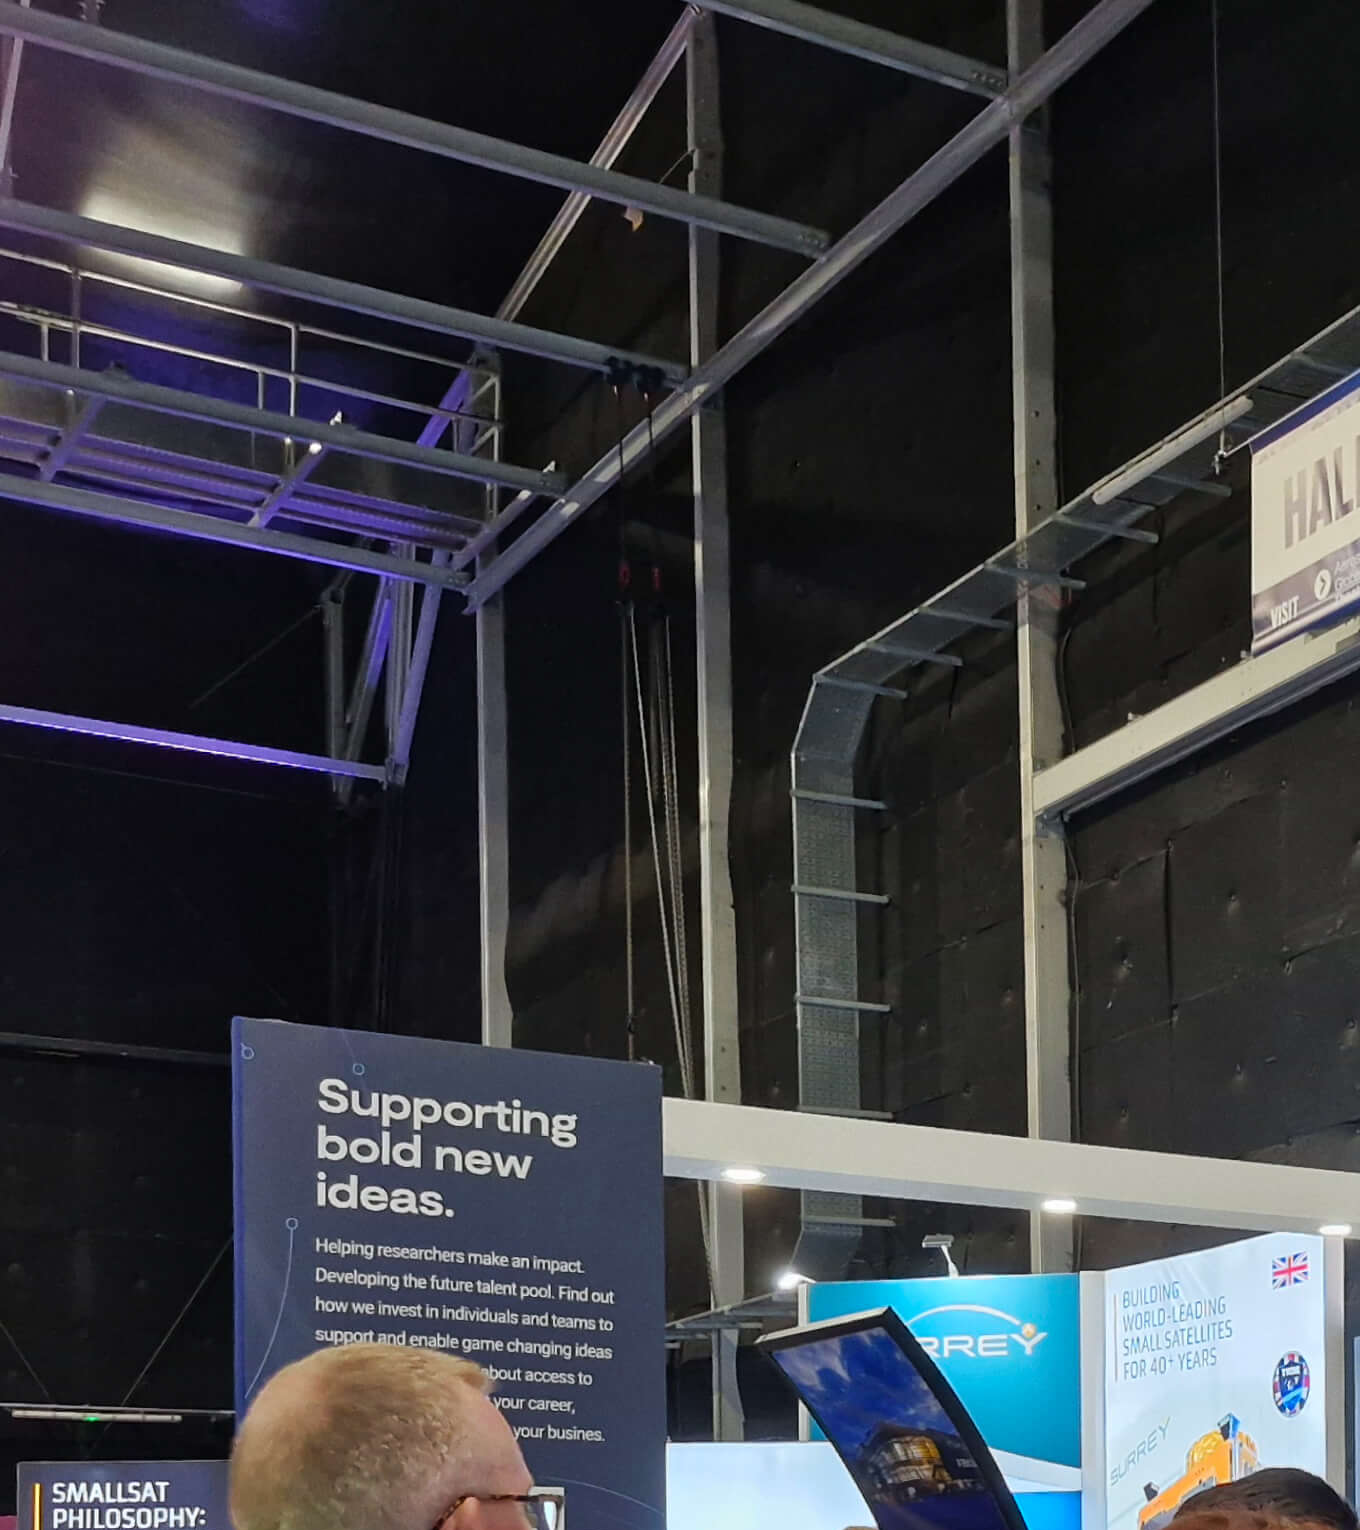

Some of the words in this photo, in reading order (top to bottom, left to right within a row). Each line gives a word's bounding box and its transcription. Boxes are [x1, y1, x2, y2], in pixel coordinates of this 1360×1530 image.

[1270, 595, 1299, 628] VISIT
[317, 1078, 578, 1147] Supporting
[317, 1125, 421, 1167] bold
[435, 1146, 533, 1178] new
[316, 1172, 454, 1216] ideas.
[315, 1237, 374, 1260] Helping
[377, 1245, 465, 1263] researchers
[467, 1251, 509, 1267] make
[510, 1256, 530, 1269] an
[532, 1255, 585, 1274] impact.
[315, 1267, 400, 1290] Developing
[402, 1272, 427, 1289] the
[429, 1274, 473, 1292] future
[476, 1279, 517, 1296] talent
[519, 1284, 554, 1300] pool.
[558, 1285, 588, 1302] Find
[590, 1290, 614, 1304] out
[1122, 1280, 1180, 1309] BUILDING
[314, 1295, 348, 1313] how
[351, 1302, 375, 1315] we
[377, 1300, 422, 1317] invest
[425, 1303, 439, 1319] in
[441, 1305, 519, 1324] individuals
[521, 1311, 548, 1327] and
[550, 1314, 596, 1330] teams
[598, 1317, 613, 1331] to
[1122, 1295, 1227, 1333] WORLD-LEADING
[316, 1330, 373, 1343] support
[378, 1331, 405, 1346] and
[410, 1334, 459, 1350] enable
[461, 1338, 503, 1353] game
[506, 1338, 571, 1360] changing
[575, 1342, 612, 1359] ideas
[524, 1370, 575, 1384] access
[577, 1371, 592, 1386] to
[1123, 1358, 1146, 1380] FOR
[1150, 1354, 1174, 1376] 40+
[1178, 1347, 1217, 1372] YEARS
[494, 1398, 524, 1410] your
[527, 1398, 575, 1414] career,
[513, 1427, 542, 1441] your
[547, 1424, 605, 1441] busines.
[1110, 1415, 1171, 1487] SURREY
[51, 1481, 170, 1503] SMALLSAT
[52, 1506, 207, 1530] PHILOSOPHY:
